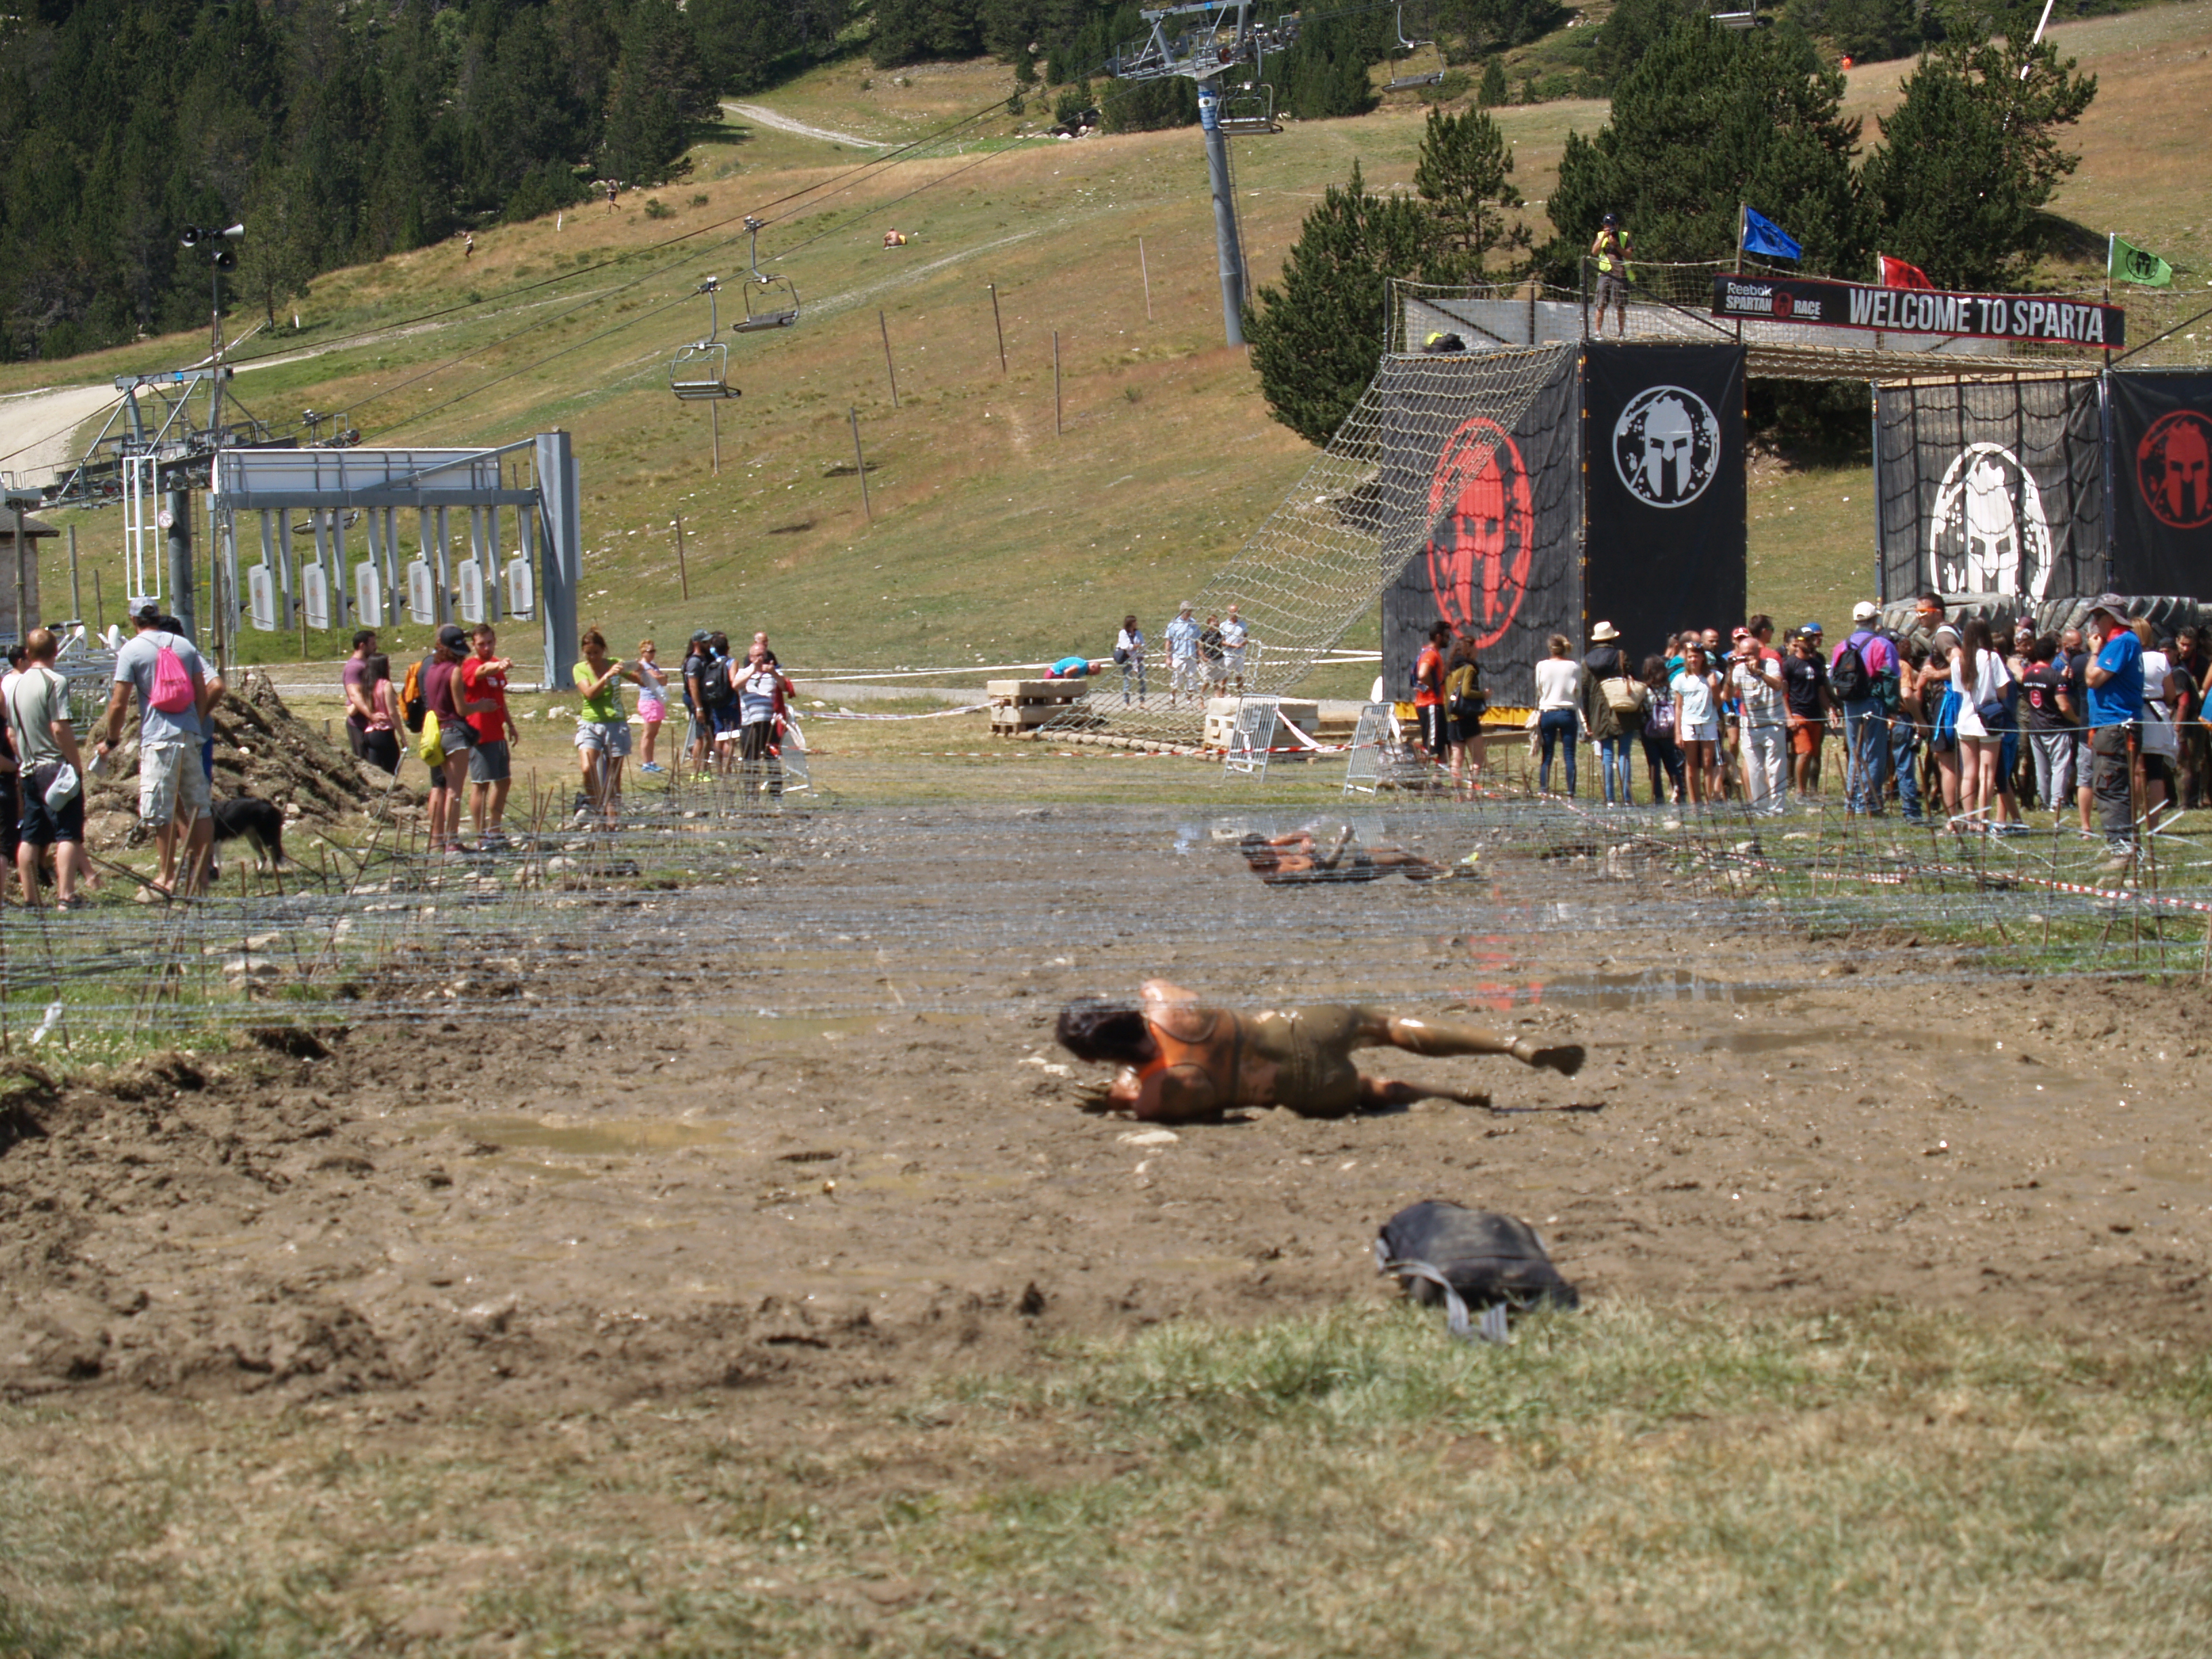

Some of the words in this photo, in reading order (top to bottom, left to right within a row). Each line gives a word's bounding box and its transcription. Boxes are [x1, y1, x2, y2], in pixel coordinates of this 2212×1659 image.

[1727, 282, 1773, 297] Reebok
[1725, 295, 1773, 312] SPARTAN
[1794, 300, 1821, 315] RACE
[1849, 288, 1971, 333] WELCOME
[1978, 298, 2007, 334] TO
[2012, 300, 2104, 343] SPARTA
